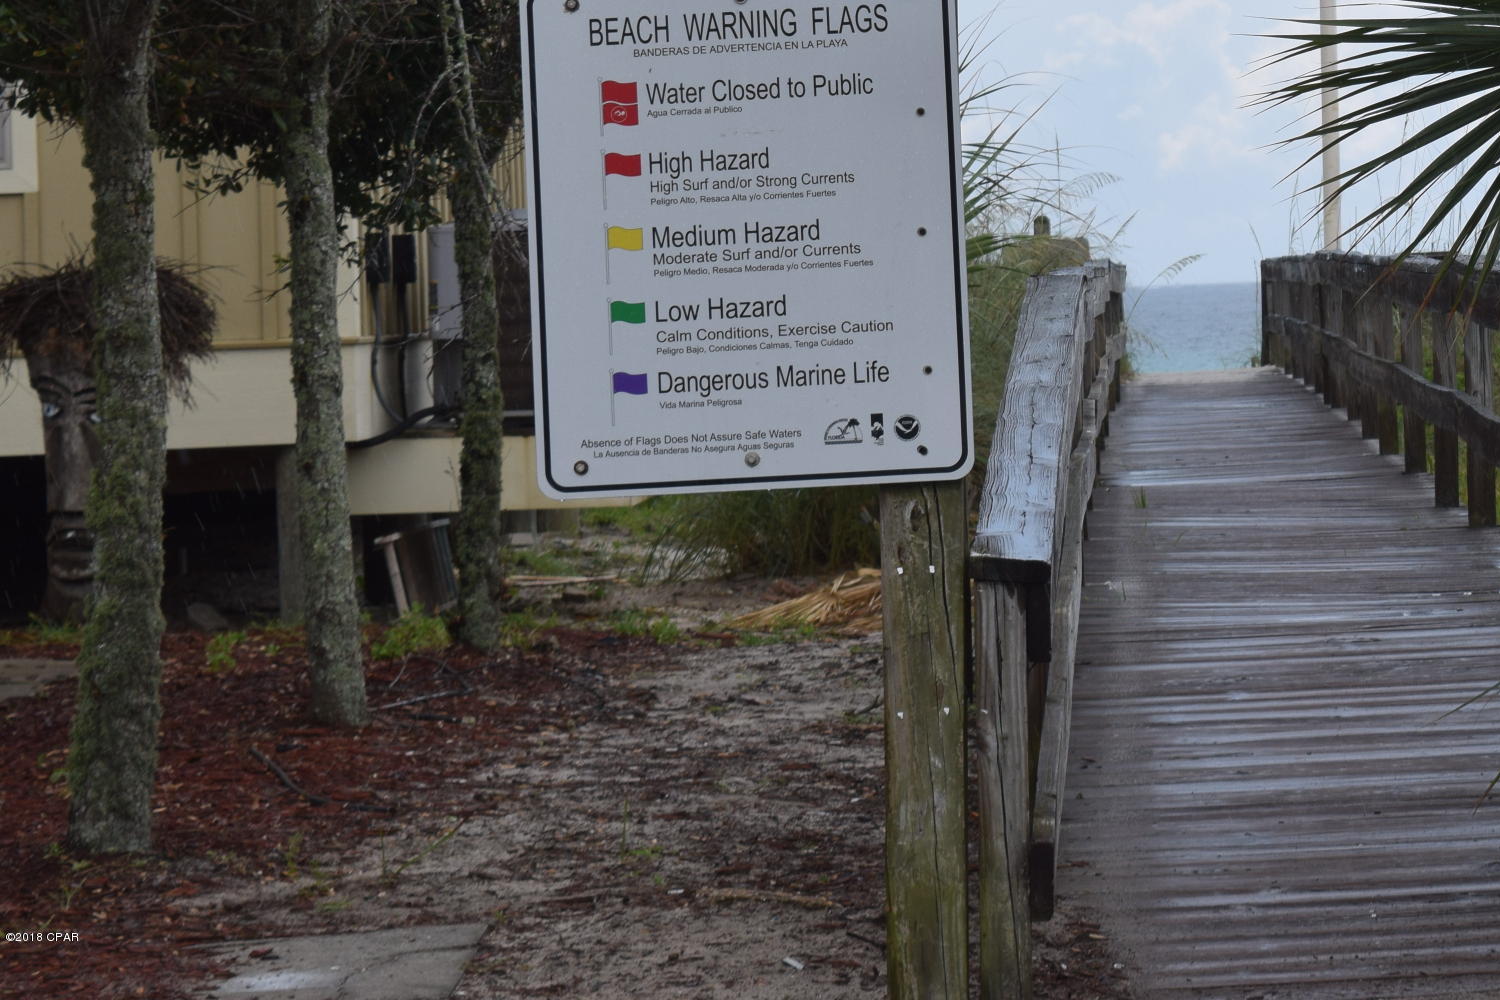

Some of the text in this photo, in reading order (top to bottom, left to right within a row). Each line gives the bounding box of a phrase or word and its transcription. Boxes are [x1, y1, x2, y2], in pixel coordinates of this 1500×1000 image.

[589, 3, 888, 46] BEACH WARNING FLAGS
[633, 38, 848, 58] BANDERAS DE ADVERTENCIA EN LA PLAYA
[646, 73, 874, 105] Water Closed to Public
[647, 105, 742, 118] Agua Cerrada al Publico
[649, 147, 769, 179] High Hazard
[650, 171, 855, 196] High Surf and/or Strong Currents
[652, 219, 820, 249] Medium Hazard
[653, 243, 861, 266] Moderate Surf and/or Currents
[655, 294, 787, 322] Low Hazard
[656, 320, 894, 343] Calm Conditions, Exercise Caution
[658, 360, 889, 397] Dangerous Marine Life
[581, 428, 802, 449] Absence of Flags Does Not Assure Safe Waters
